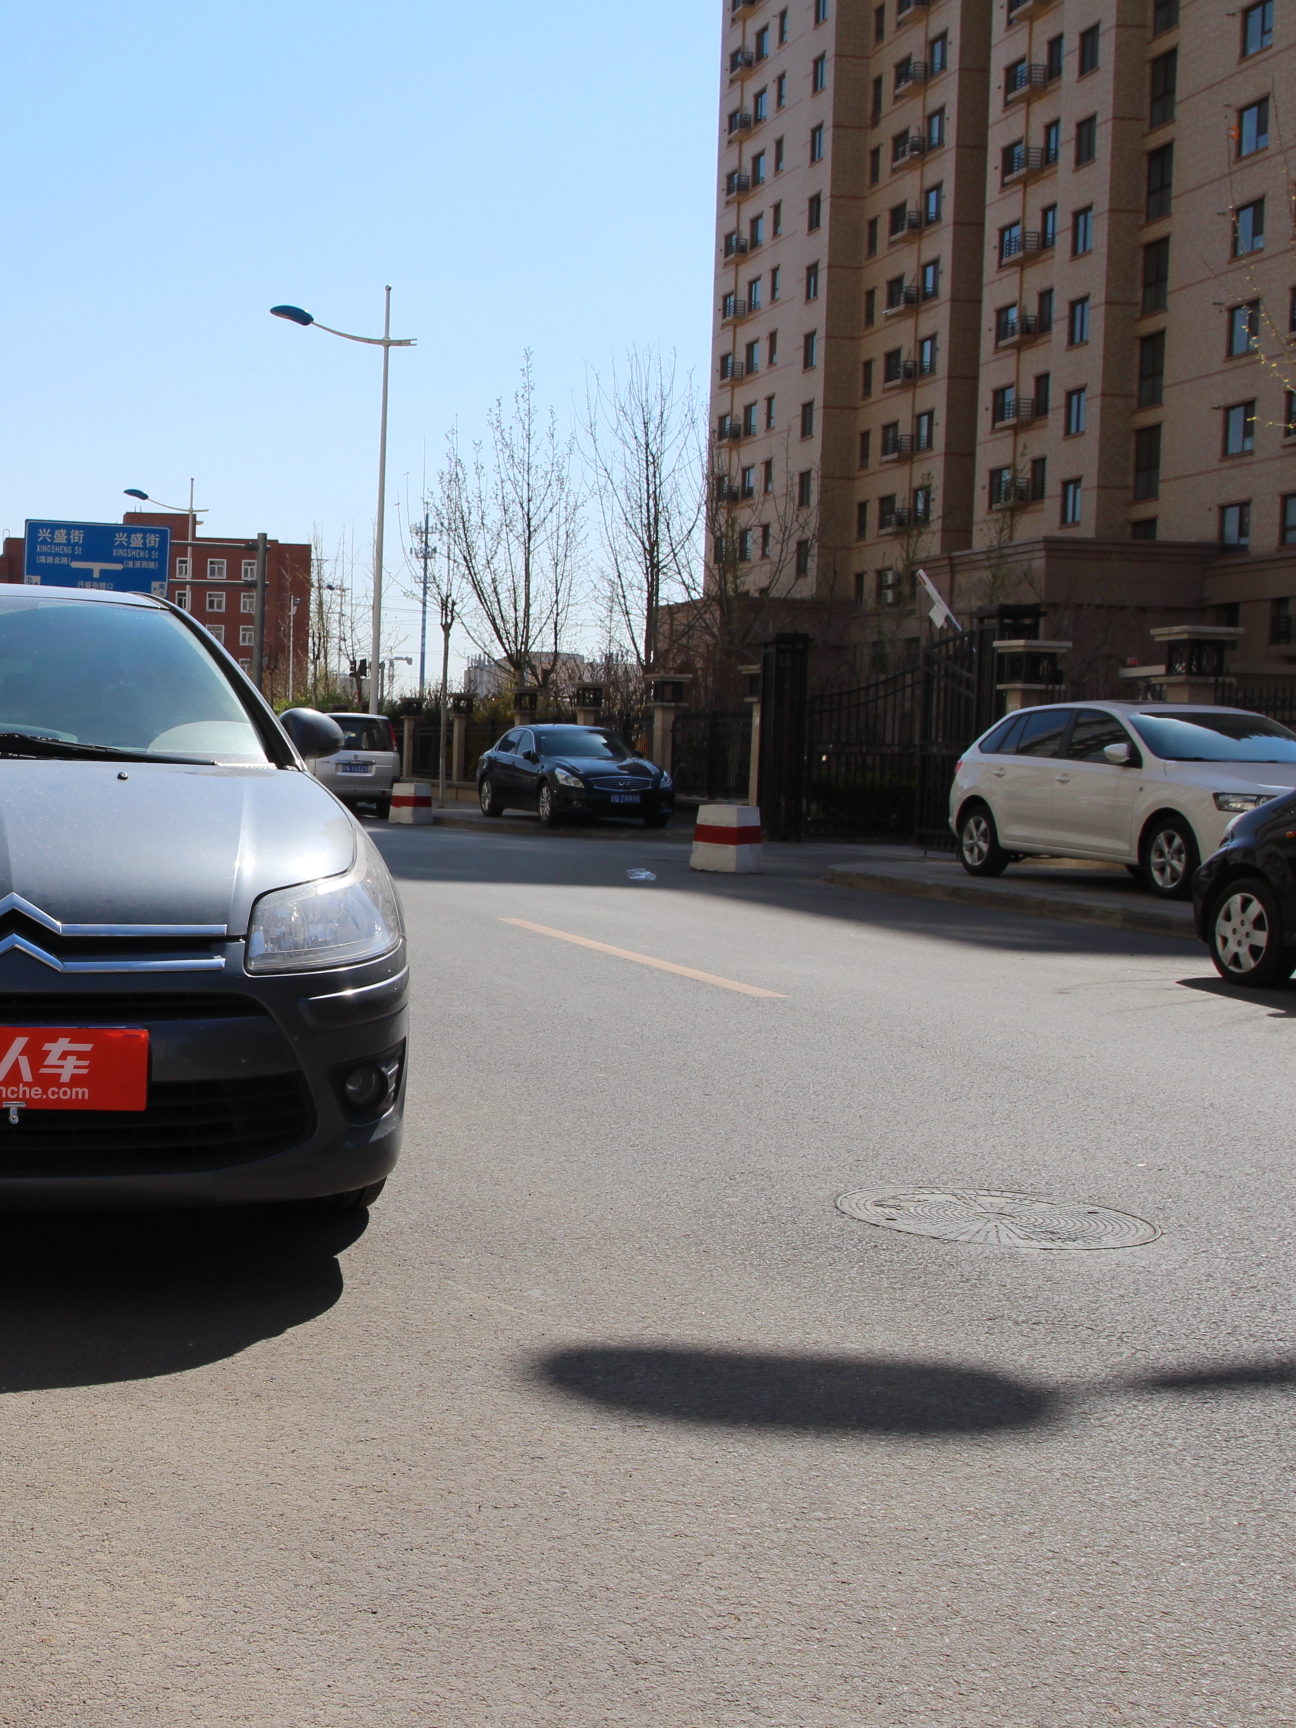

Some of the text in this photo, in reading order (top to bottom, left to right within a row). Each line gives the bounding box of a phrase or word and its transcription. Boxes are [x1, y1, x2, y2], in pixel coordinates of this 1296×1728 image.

[37, 528, 84, 544] 兴盛街
[114, 532, 160, 548] 兴盛街
[36, 544, 82, 555] XINGSHENG St
[112, 548, 158, 559] XINGSHENG St
